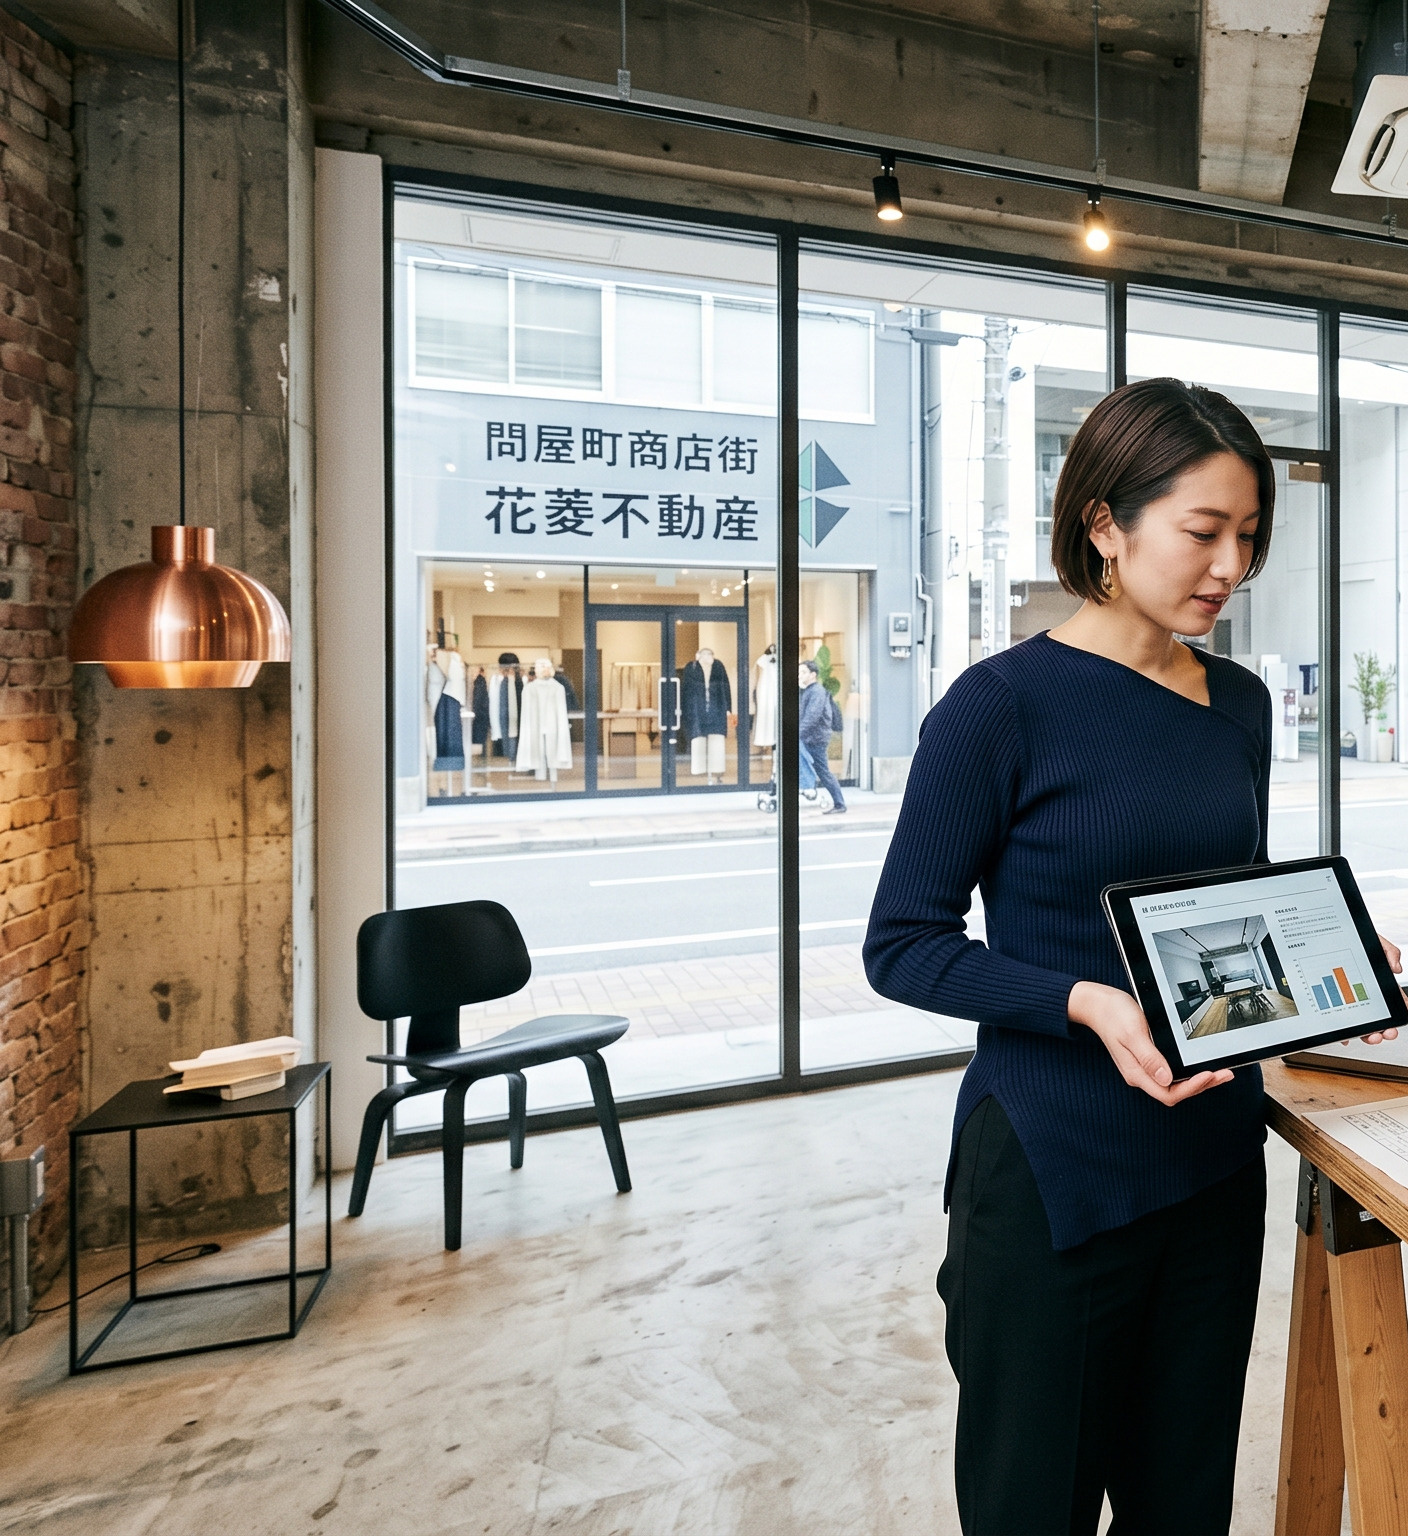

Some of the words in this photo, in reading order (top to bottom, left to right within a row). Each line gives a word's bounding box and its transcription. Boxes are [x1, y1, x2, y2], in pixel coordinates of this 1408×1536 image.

[487, 421, 758, 475] 問屋町商店街
[485, 486, 758, 541] 花菱不動産
